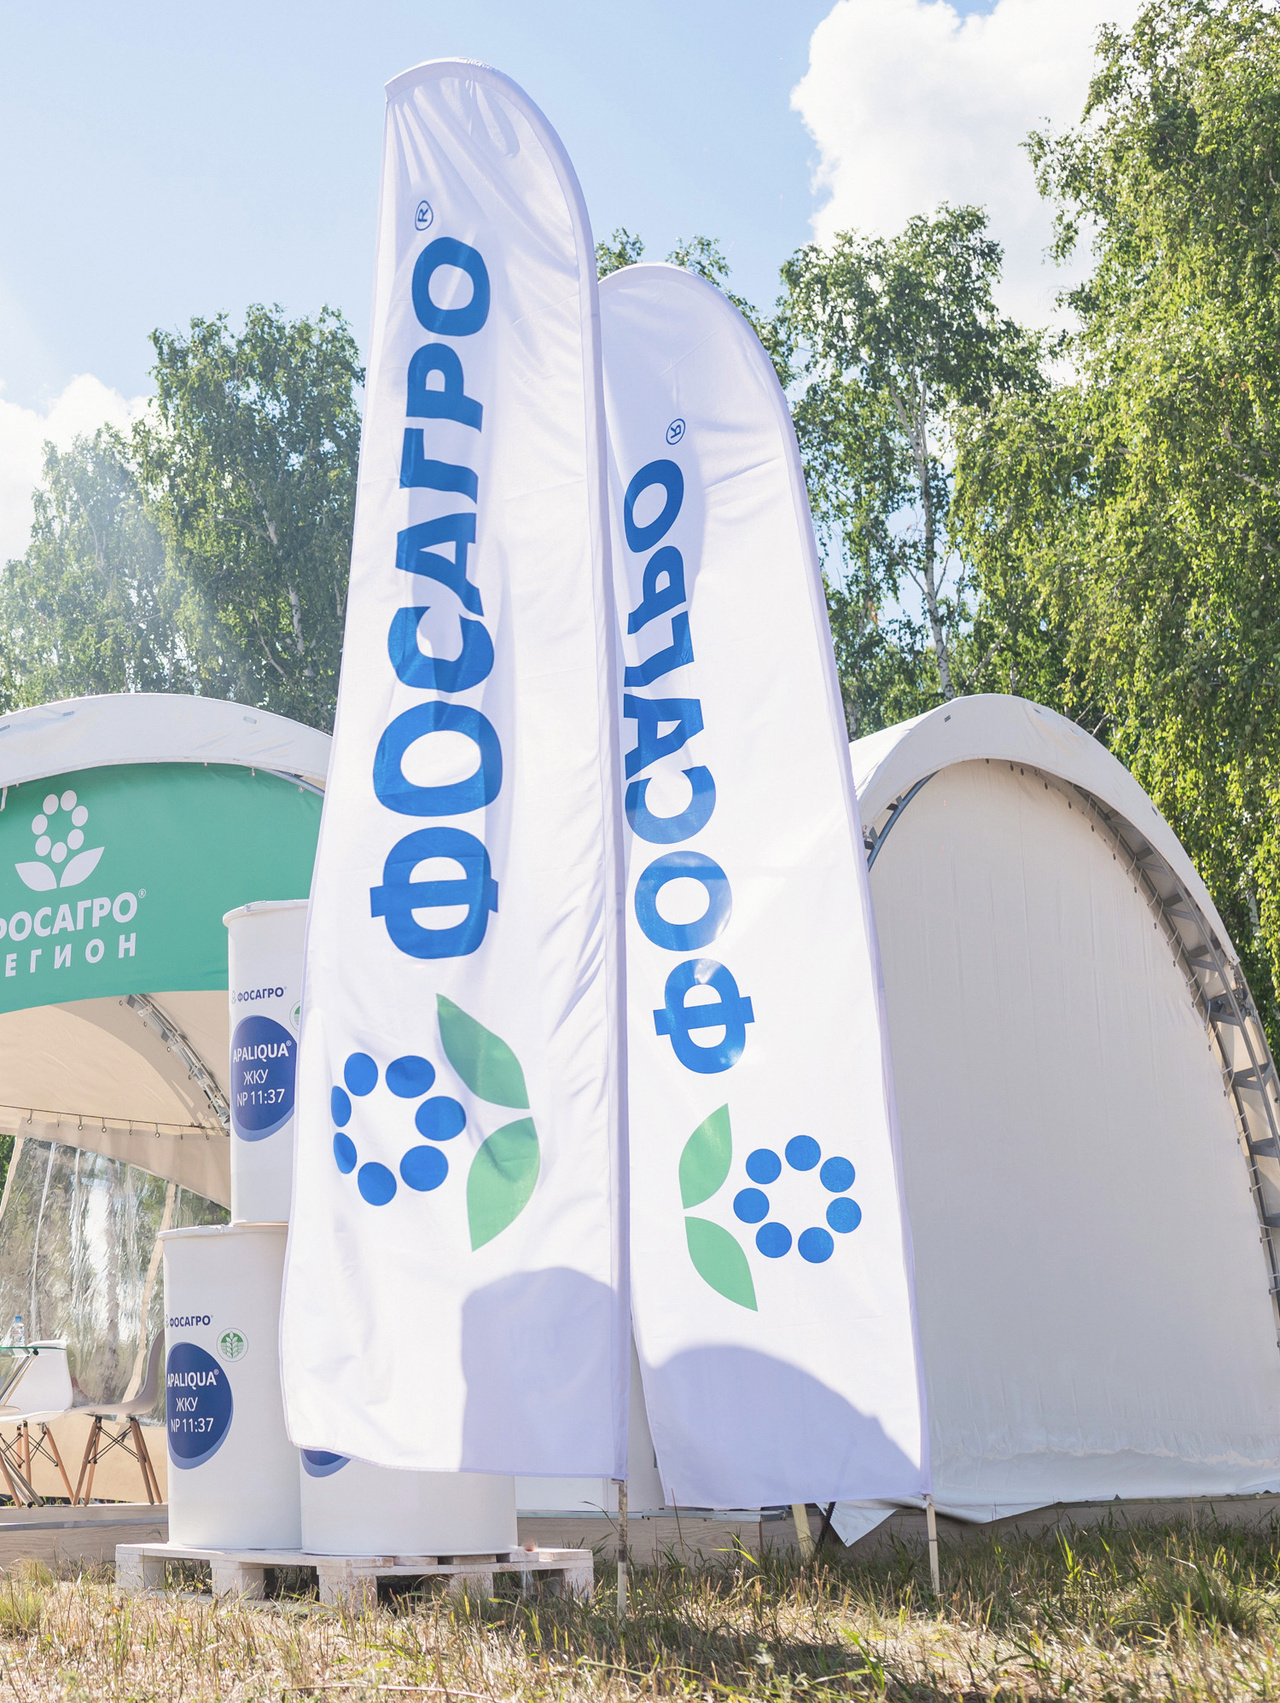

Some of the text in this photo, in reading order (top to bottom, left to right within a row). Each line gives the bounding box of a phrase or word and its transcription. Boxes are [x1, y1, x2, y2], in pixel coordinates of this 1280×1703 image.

[369, 236, 503, 960] ФОСАГРО
[237, 986, 284, 1002] ФОСАГРО
[233, 1042, 289, 1063] APALIQUA
[243, 1069, 268, 1086] ЖКУ
[236, 1088, 285, 1107] NP 11:37
[170, 1315, 211, 1327] ФОСАГРО
[167, 1371, 217, 1390] APALIQUA
[175, 1397, 198, 1412] ЖКУ
[170, 1417, 214, 1433] NP 11:37
